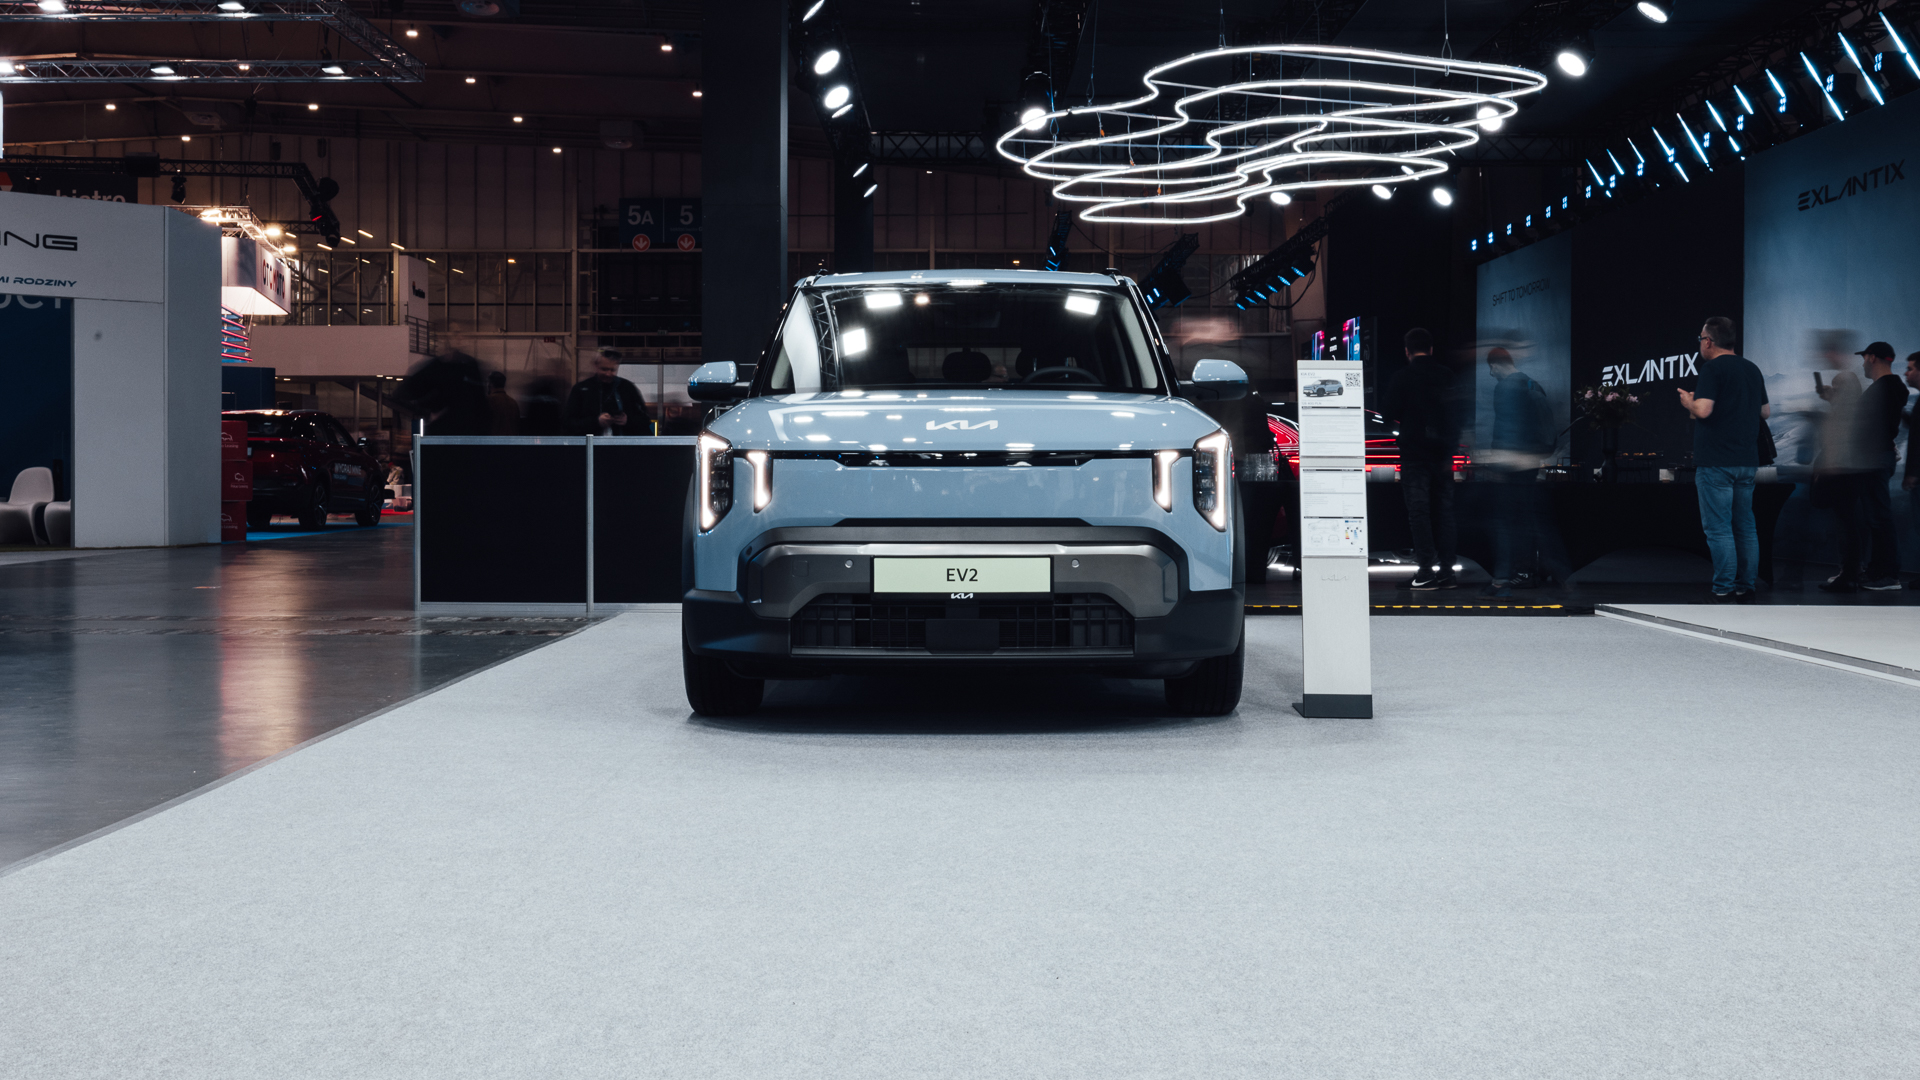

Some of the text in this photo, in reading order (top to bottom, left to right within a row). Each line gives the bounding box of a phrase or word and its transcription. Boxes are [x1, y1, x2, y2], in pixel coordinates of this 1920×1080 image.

[1797, 158, 1906, 212] EXLANTIX
[627, 205, 654, 225] 5A
[680, 205, 693, 225] 5
[13, 277, 77, 287] RODZINY
[1601, 351, 1699, 388] EXLANTIX
[946, 568, 978, 582] EV2
